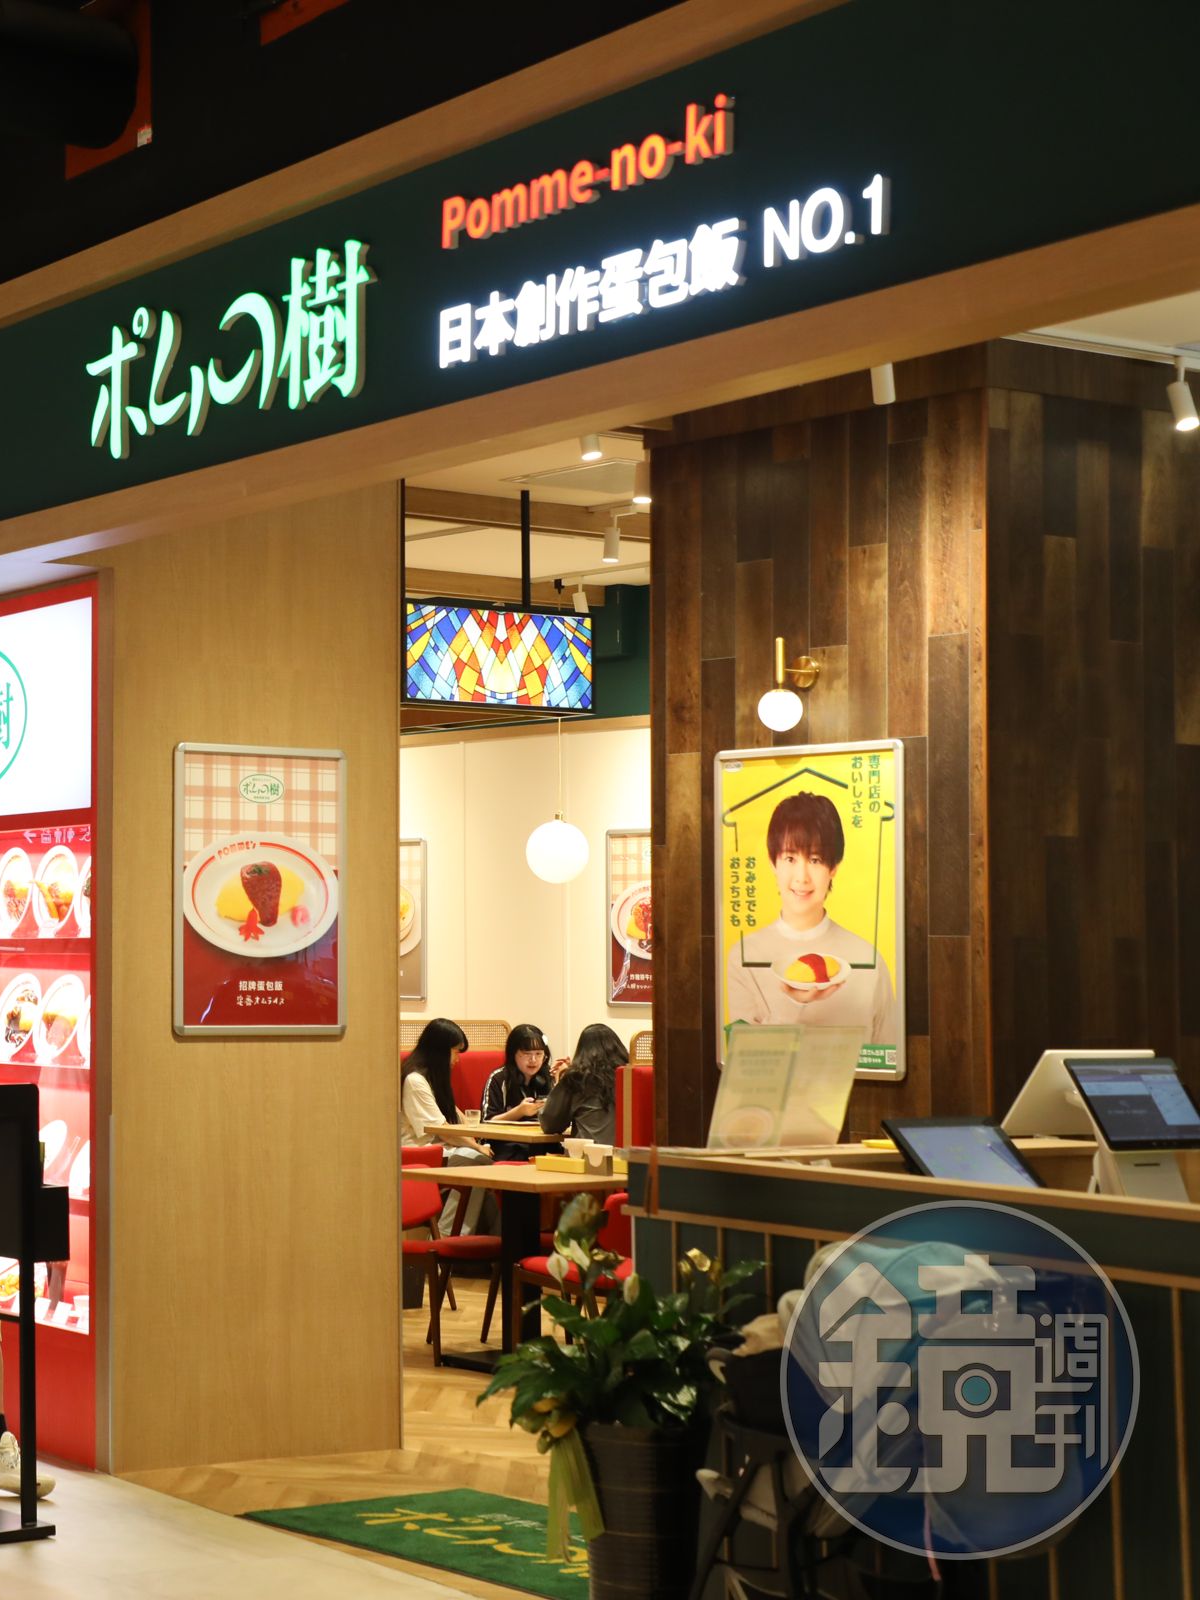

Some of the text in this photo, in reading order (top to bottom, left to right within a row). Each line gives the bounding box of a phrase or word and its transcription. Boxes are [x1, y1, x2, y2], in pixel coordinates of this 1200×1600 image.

[442, 92, 730, 251] Pomme-no-ki
[438, 173, 886, 369] 日本創作蛋包飯 NO.1
[85, 239, 372, 460] ポムの樹
[851, 755, 863, 829] おいしさを
[868, 754, 881, 814] 専門店の
[729, 856, 741, 927] おうちでも
[745, 856, 757, 927] おみせでも
[239, 980, 283, 991] 招牌蛋包飯
